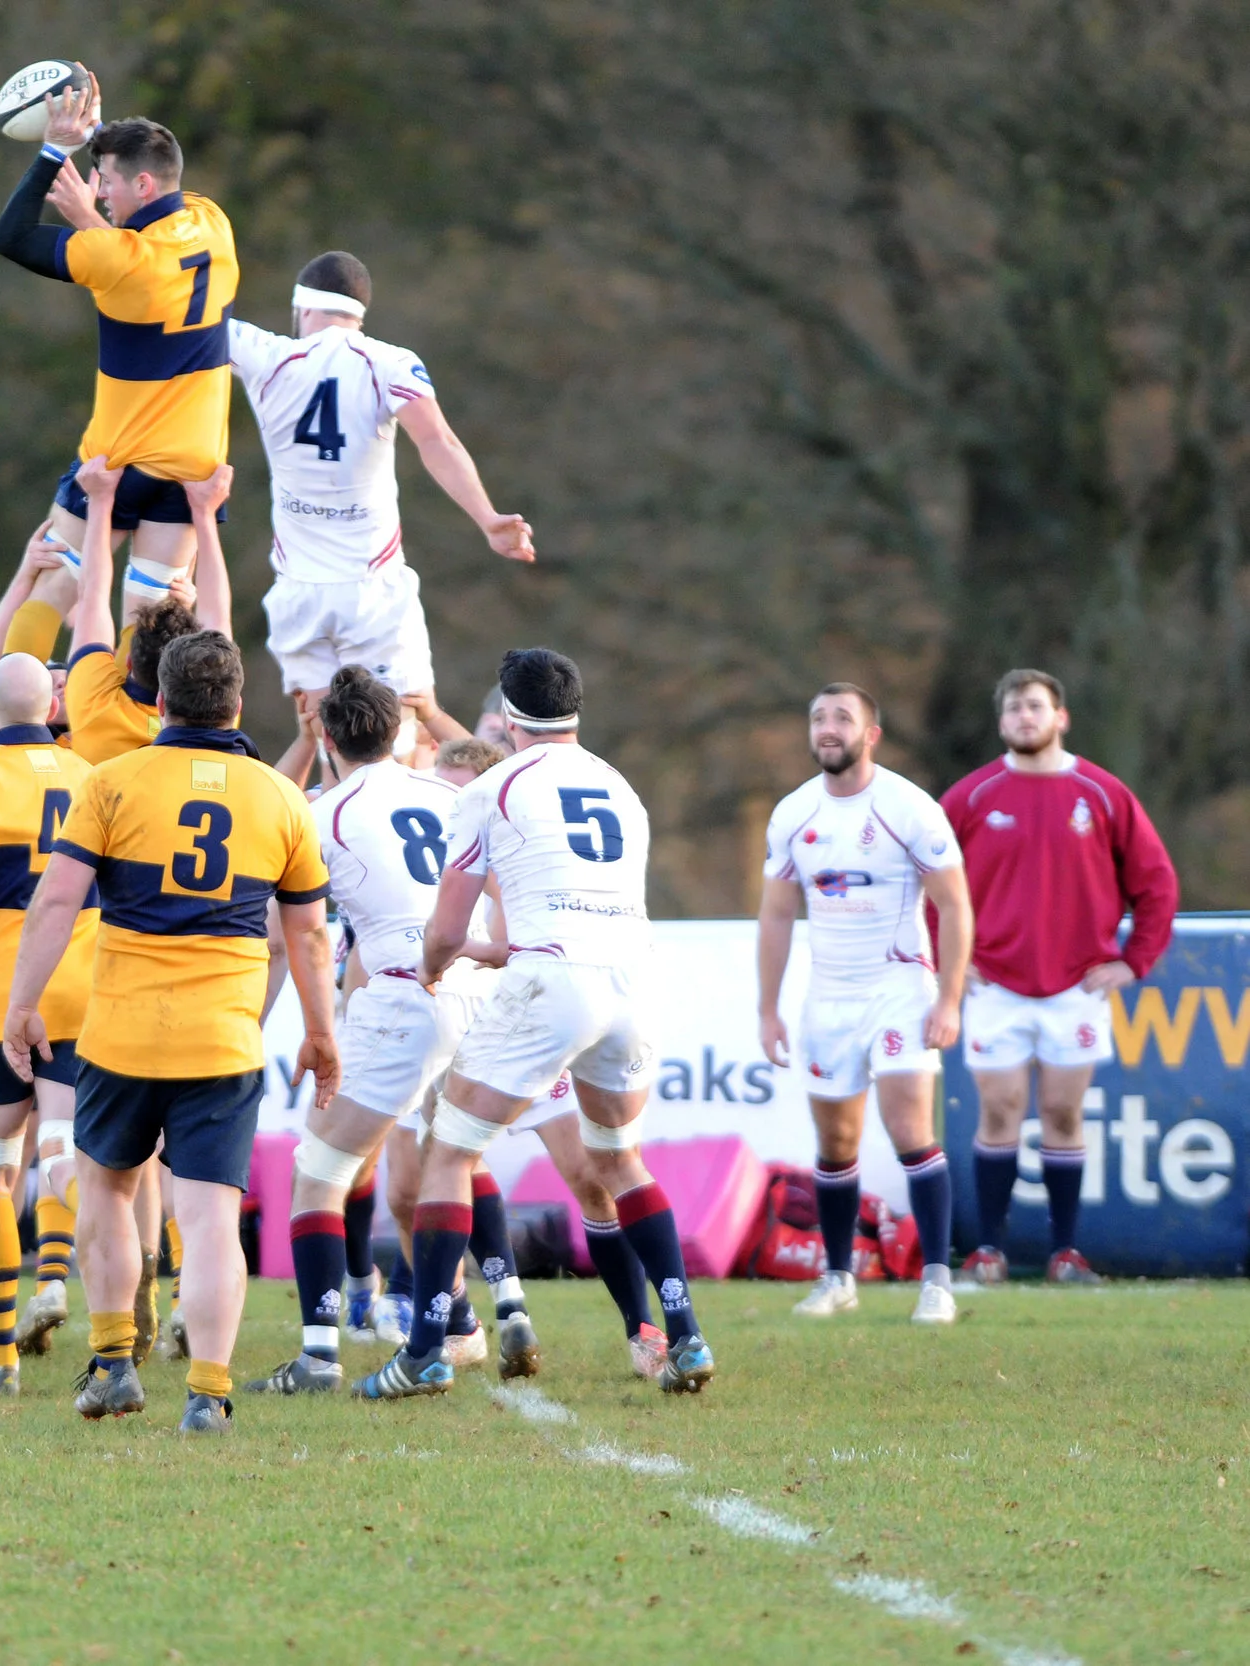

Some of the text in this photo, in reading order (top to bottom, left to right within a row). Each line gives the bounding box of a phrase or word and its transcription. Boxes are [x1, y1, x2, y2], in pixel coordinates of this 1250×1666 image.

[179, 249, 212, 327] 7
[293, 376, 347, 462] 4
[171, 799, 233, 892] 3
[390, 807, 447, 886] 8
[557, 786, 624, 863] 5
[657, 1044, 775, 1104] aks
